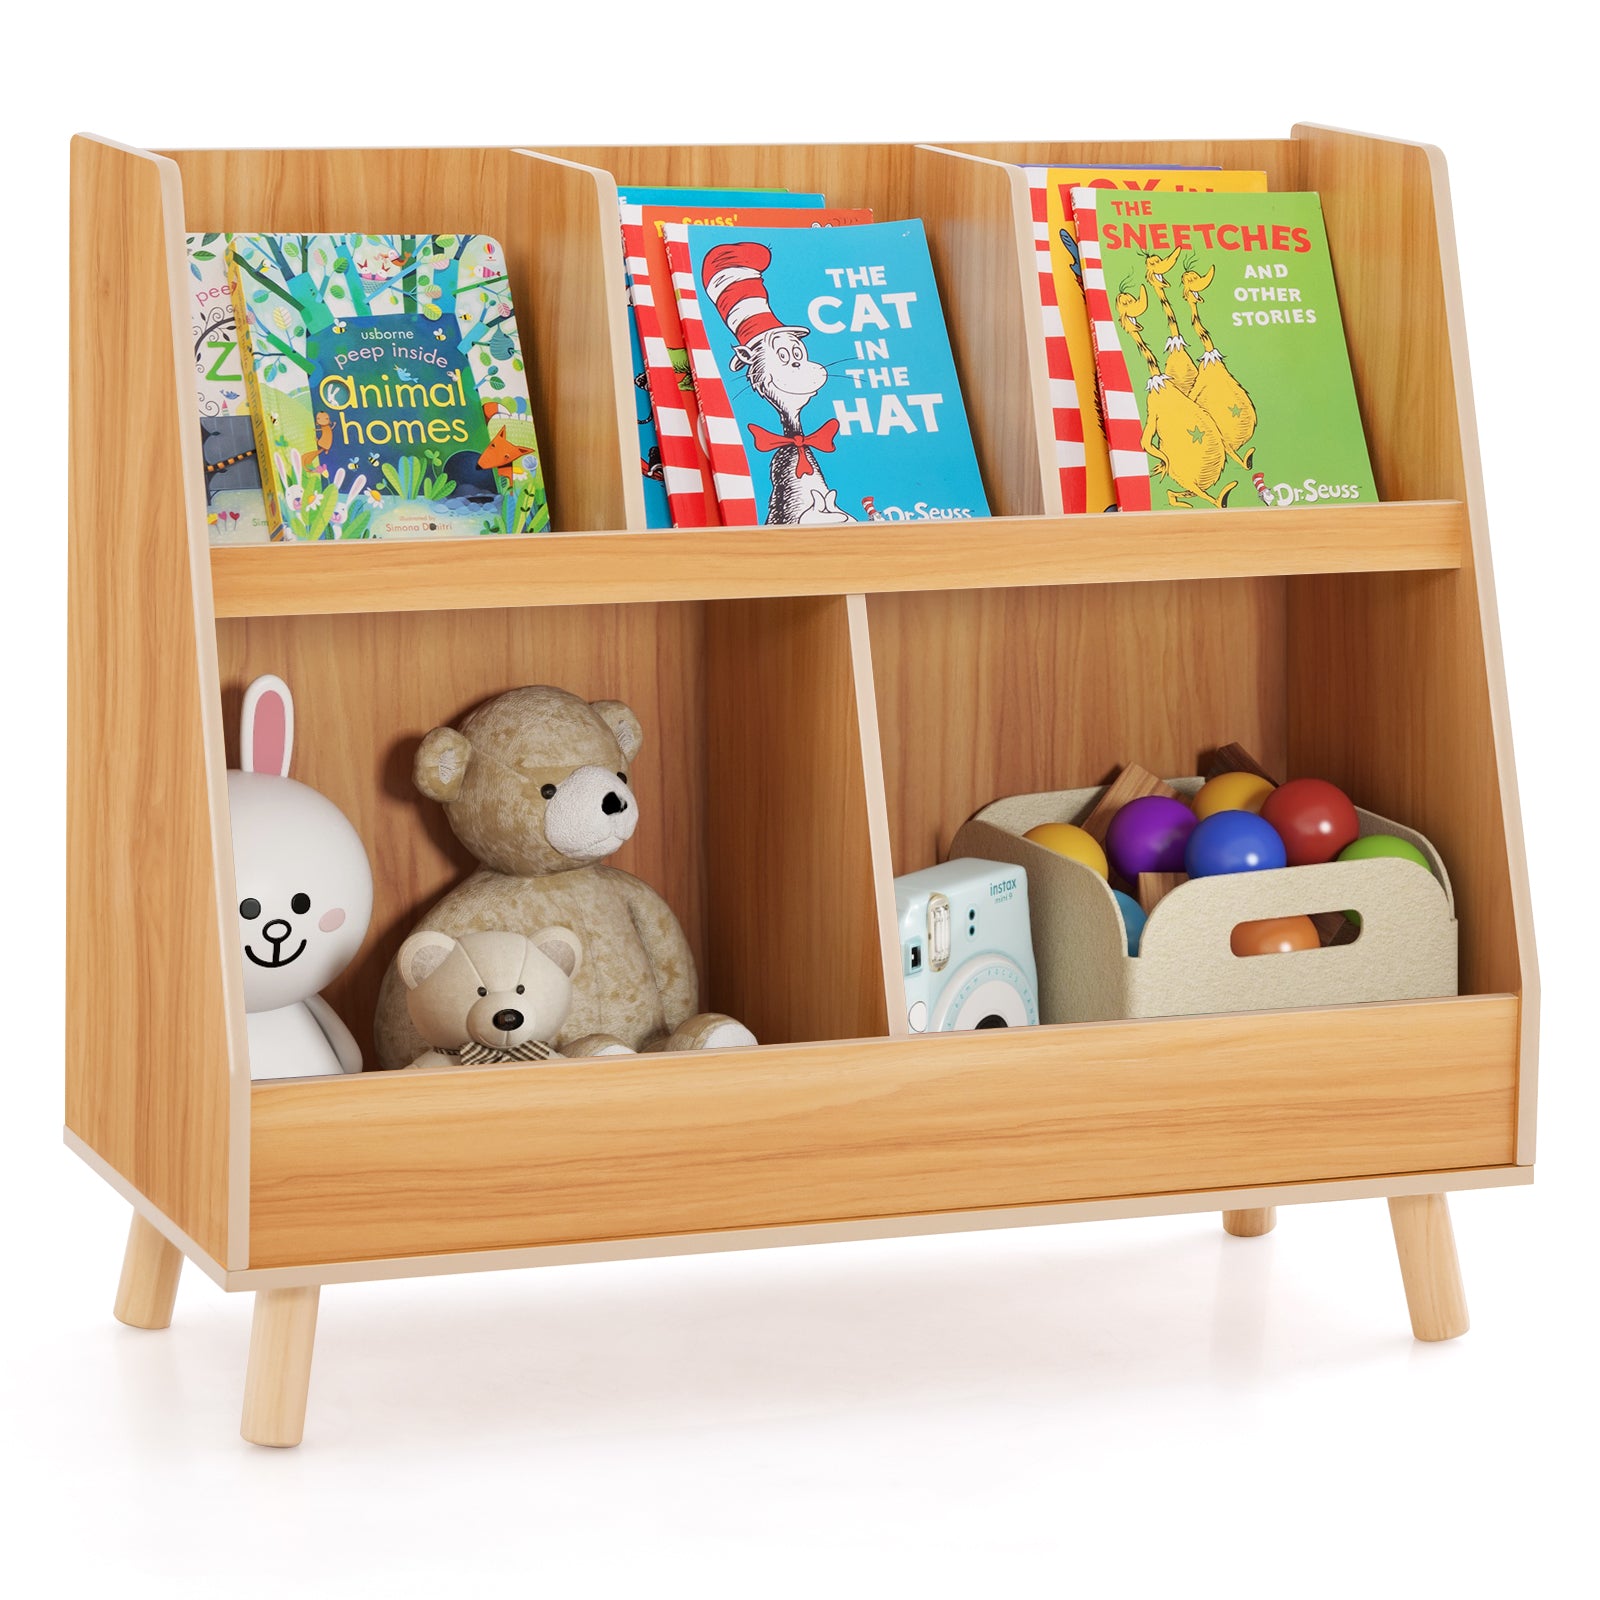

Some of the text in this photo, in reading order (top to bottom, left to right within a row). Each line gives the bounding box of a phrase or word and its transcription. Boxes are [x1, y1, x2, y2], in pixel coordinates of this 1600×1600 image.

[1111, 200, 1152, 216] THE
[1102, 223, 1312, 253] SNEETCHES
[825, 265, 887, 288] THE
[1244, 264, 1288, 280] AND
[1234, 287, 1302, 302] OTHER
[807, 292, 918, 334] CAT
[1232, 309, 1317, 327] STORIES
[361, 328, 414, 340] usborne
[334, 343, 448, 370] peep inside
[854, 338, 890, 361] IN
[845, 366, 910, 389] THE
[319, 369, 466, 410] animal
[832, 393, 944, 436] HAT
[339, 412, 469, 445] homes
[386, 523, 419, 532] Simona
[990, 878, 1016, 896] instax
